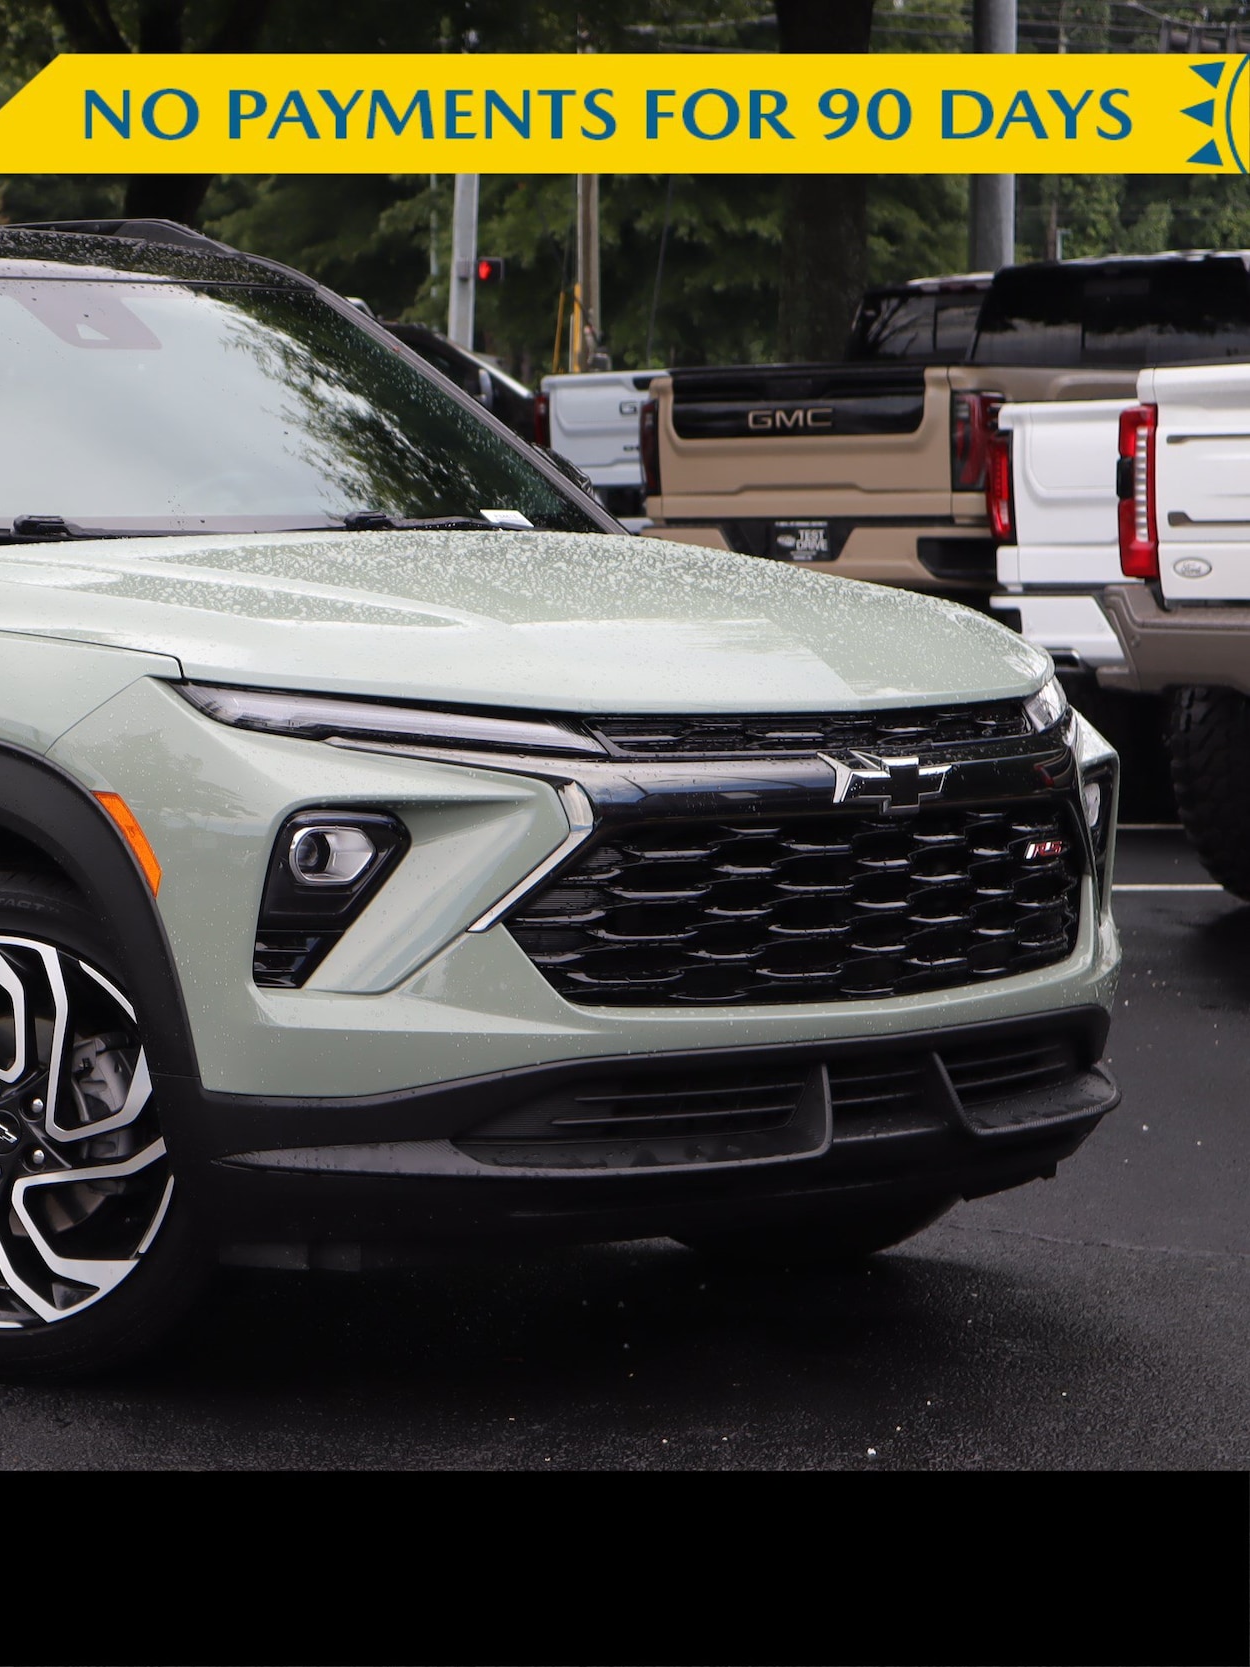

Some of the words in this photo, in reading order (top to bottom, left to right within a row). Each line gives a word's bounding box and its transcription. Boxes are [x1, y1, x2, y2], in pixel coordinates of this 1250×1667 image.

[748, 407, 833, 429] GMC
[798, 529, 825, 540] TEST
[796, 540, 828, 551] DRIVE
